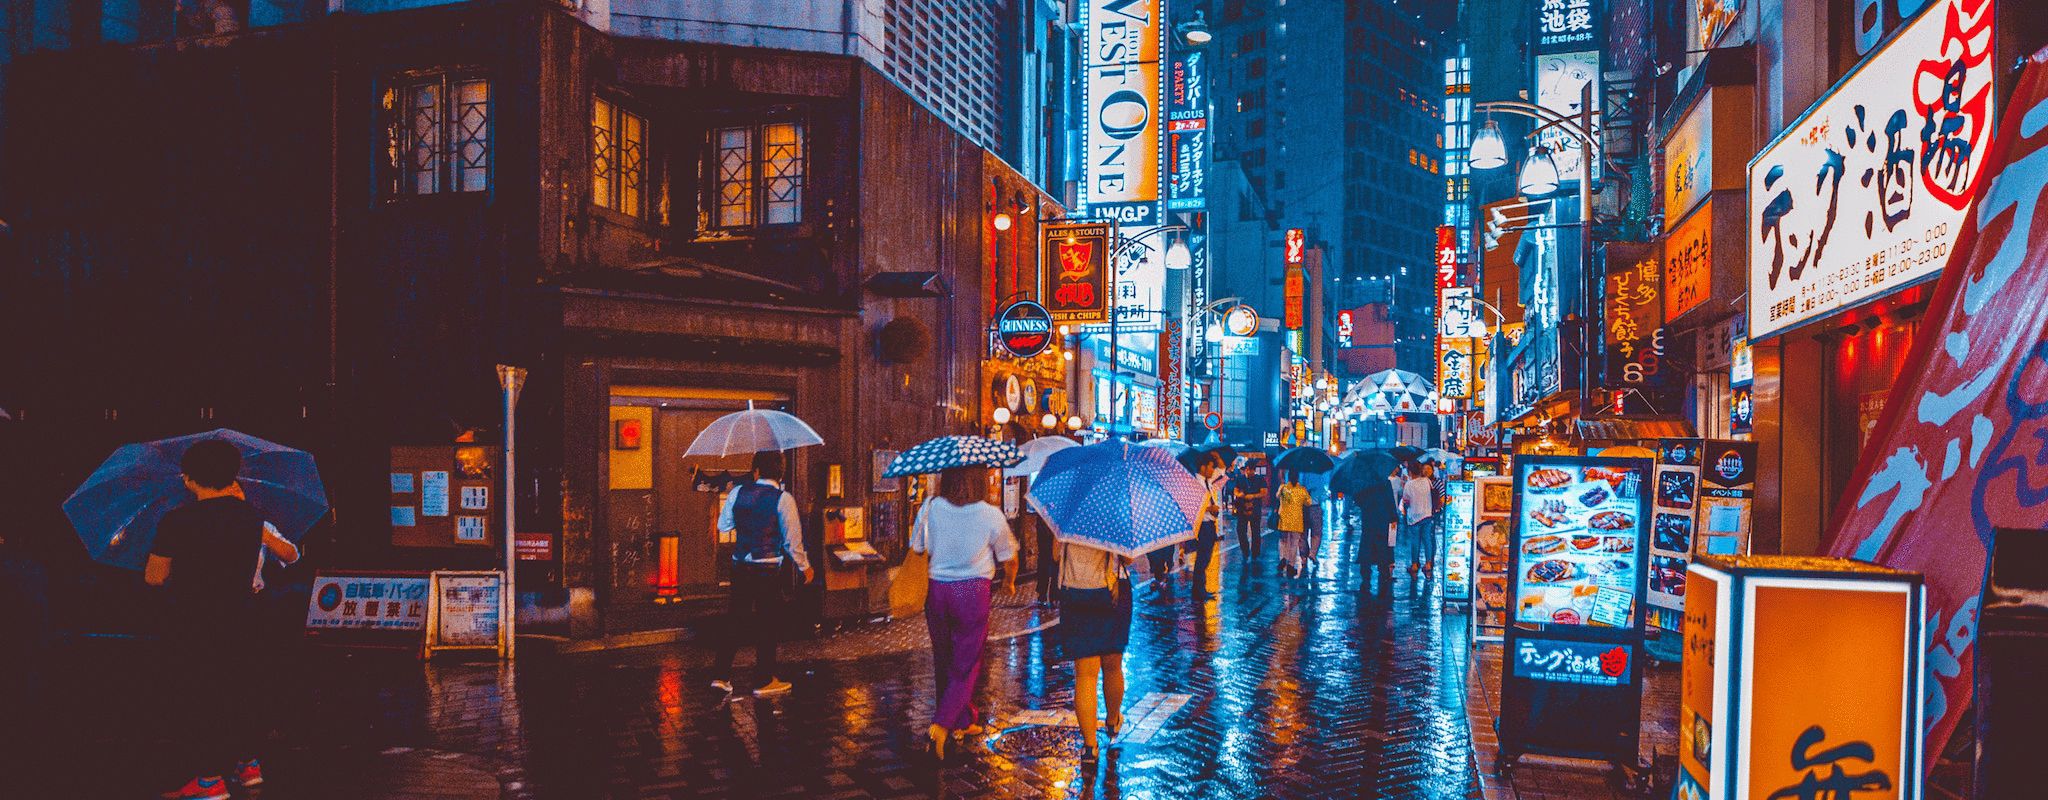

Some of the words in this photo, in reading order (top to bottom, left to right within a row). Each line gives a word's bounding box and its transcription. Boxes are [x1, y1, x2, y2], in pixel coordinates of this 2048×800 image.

[1540, 9, 1593, 32] 池袋
[1128, 30, 1139, 73] HOTEL
[1187, 52, 1201, 110] ダーツバー
[1170, 110, 1205, 120] BAGUS
[1098, 90, 1149, 195] ONE
[1191, 131, 1204, 197] インターネット
[1761, 59, 1973, 291] テング酒場
[1048, 229, 1065, 238] ALES
[1075, 228, 1105, 236] STOUTS
[1925, 222, 1948, 243] 0:00
[1440, 246, 1456, 288] カラ
[1635, 258, 1660, 306] 博多
[1001, 319, 1048, 333] GUINNESS
[1077, 311, 1101, 319] CHIPS
[345, 583, 426, 599] 自転車・バイク
[1520, 642, 1601, 675] テング酒場
